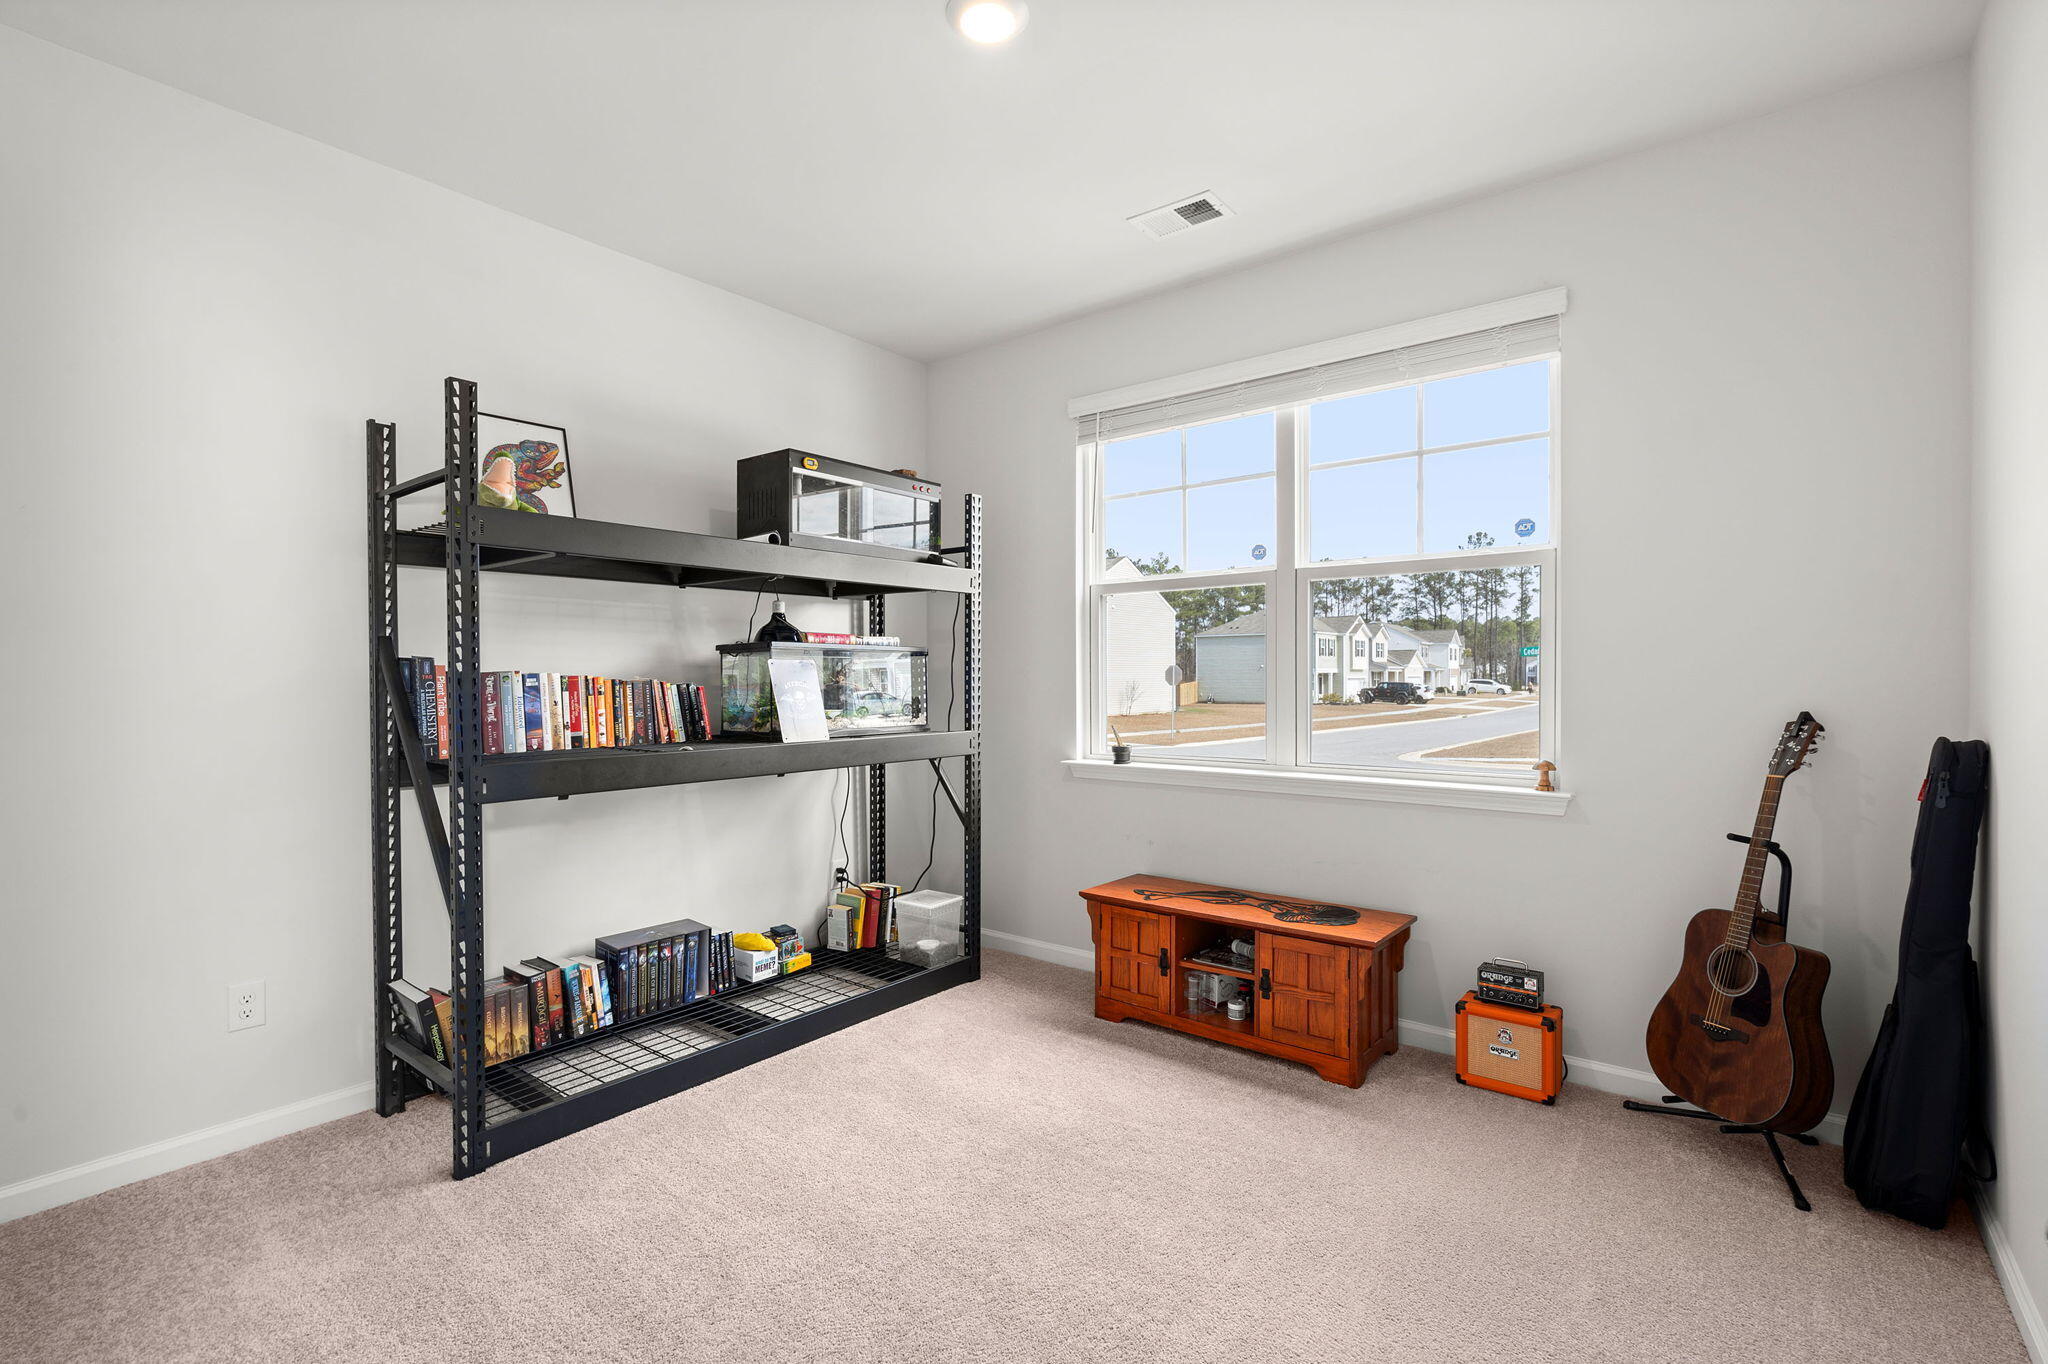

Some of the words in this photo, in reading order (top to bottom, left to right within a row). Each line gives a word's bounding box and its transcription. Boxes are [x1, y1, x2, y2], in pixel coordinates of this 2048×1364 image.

[1517, 522, 1533, 531] ADT
[1524, 648, 1540, 656] Ceda
[437, 675, 446, 695] Plant
[425, 681, 437, 740] CHEMISTRY
[438, 697, 447, 716] Tribe
[755, 961, 775, 974] MEME?
[431, 1024, 445, 1061] Herpetology
